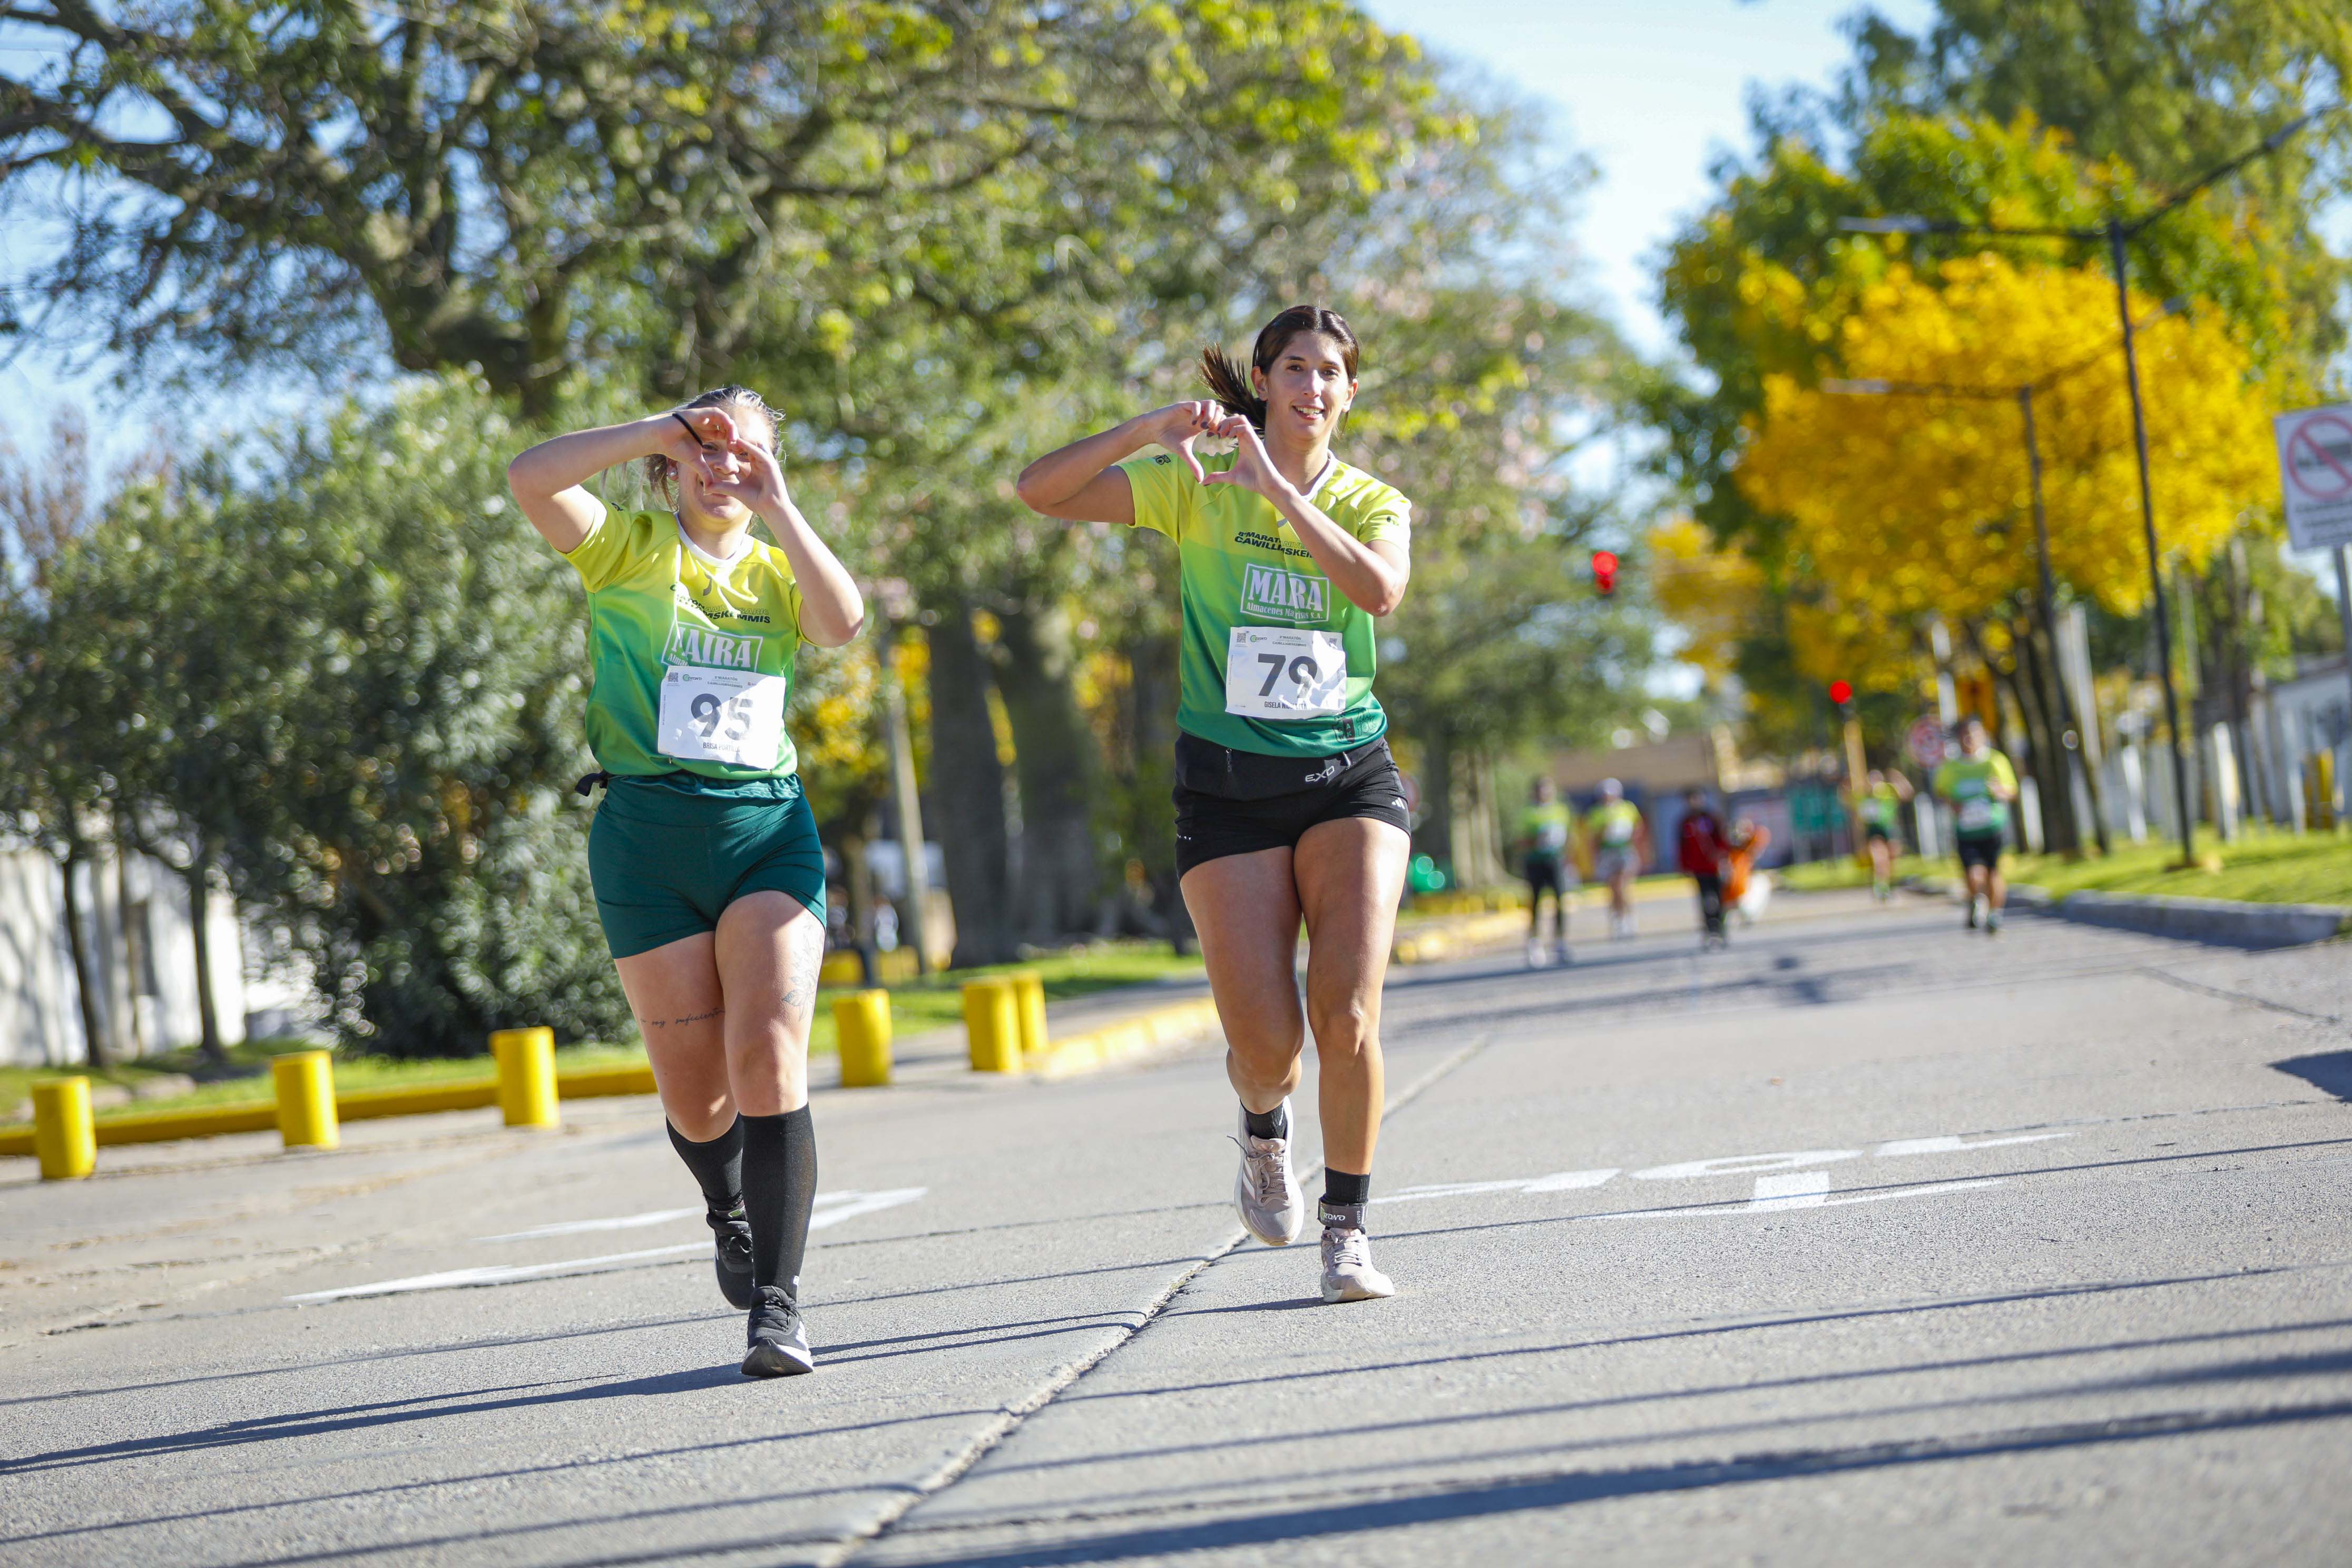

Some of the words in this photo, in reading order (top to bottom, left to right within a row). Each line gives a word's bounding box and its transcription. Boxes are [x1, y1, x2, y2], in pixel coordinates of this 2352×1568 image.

[1247, 602, 1283, 616] Almacenes
[1258, 653, 1318, 698] 79
[691, 693, 753, 740] 95
[703, 741, 718, 750] BRISA
[1305, 766, 1335, 782] EXO
